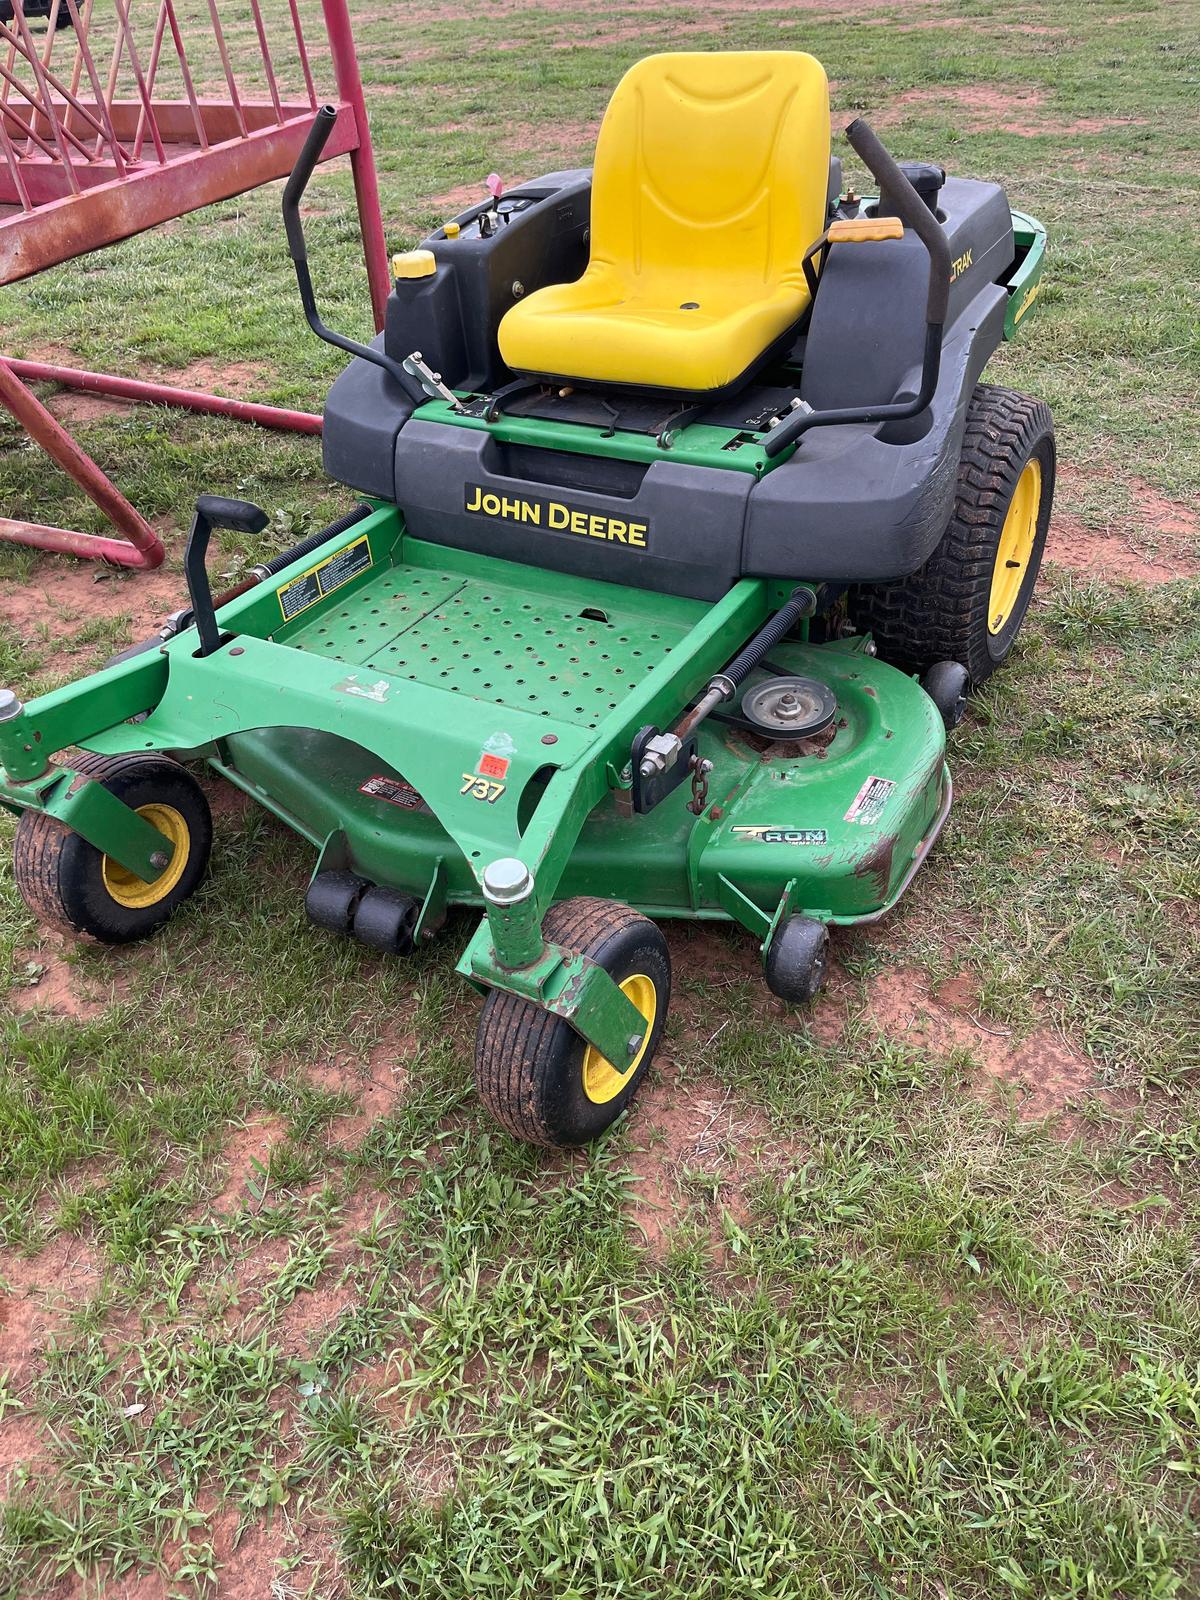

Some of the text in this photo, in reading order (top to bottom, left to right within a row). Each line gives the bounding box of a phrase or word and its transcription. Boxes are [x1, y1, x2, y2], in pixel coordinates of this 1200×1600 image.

[467, 487, 647, 547] JOHN DEERE
[460, 773, 506, 804] 737
